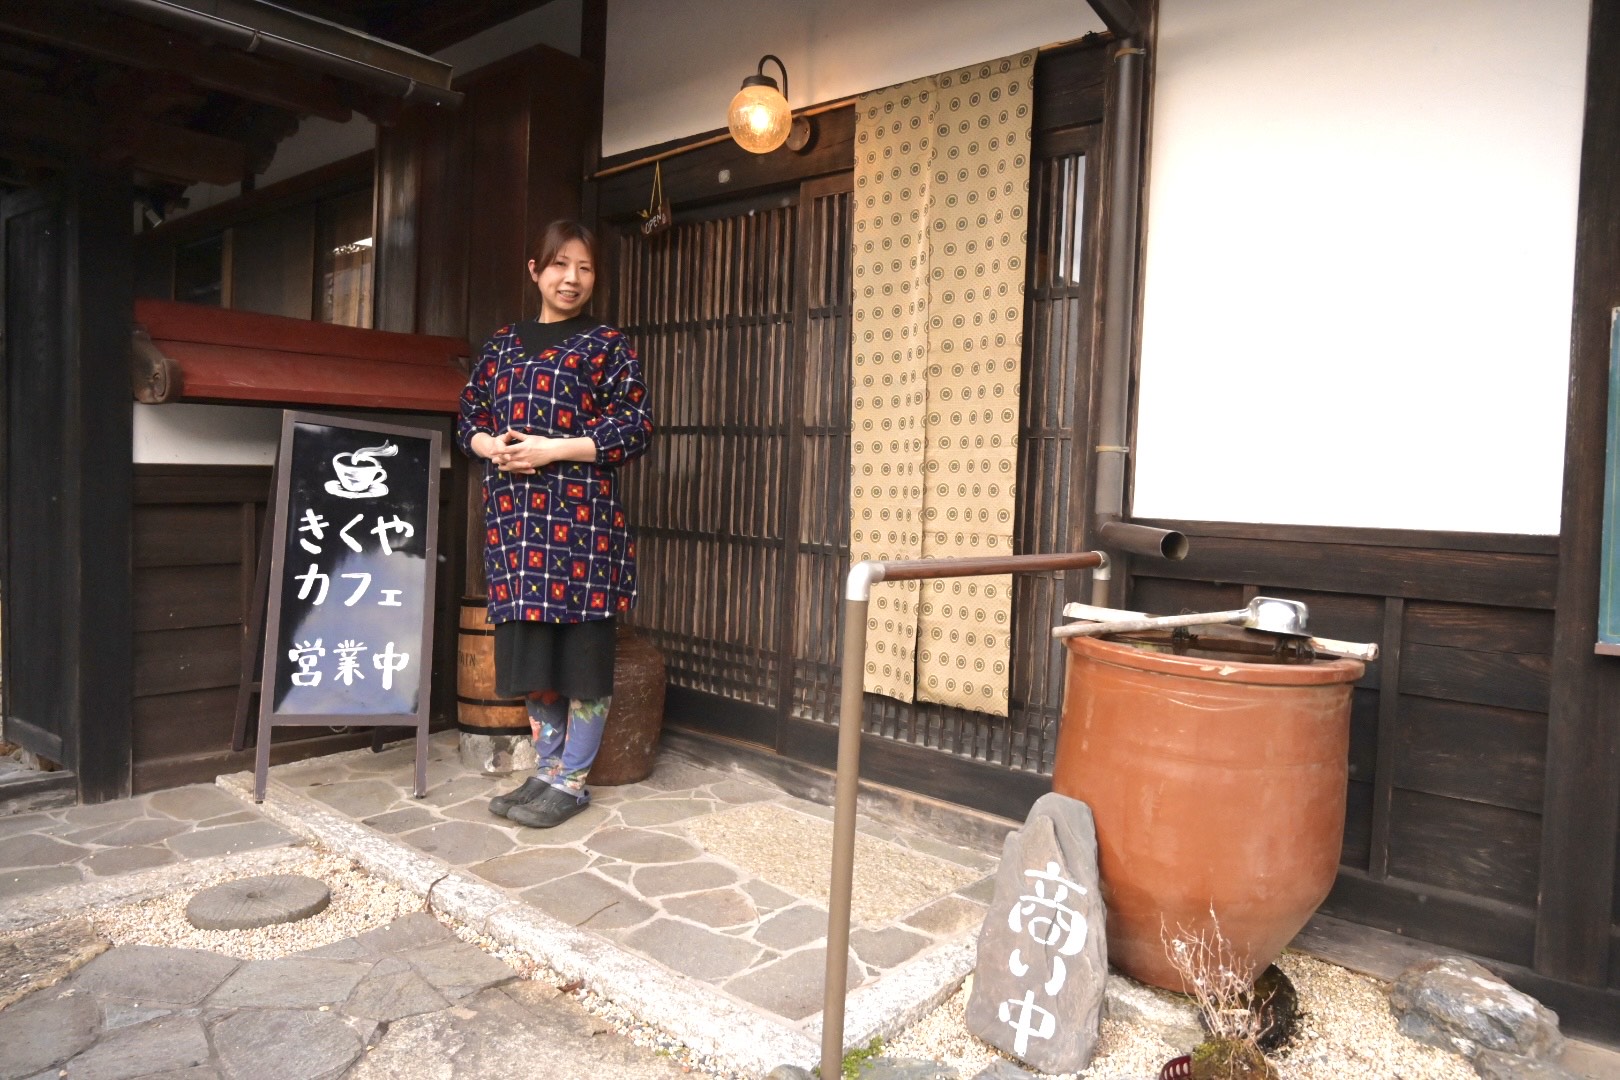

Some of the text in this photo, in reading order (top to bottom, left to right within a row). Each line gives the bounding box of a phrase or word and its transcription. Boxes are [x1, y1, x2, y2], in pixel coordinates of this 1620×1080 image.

[645, 210, 661, 234] OPEN
[298, 508, 414, 555] きくや
[294, 563, 403, 607] カフェ
[288, 637, 409, 691] 営業中
[998, 861, 1088, 1057] 商い中
